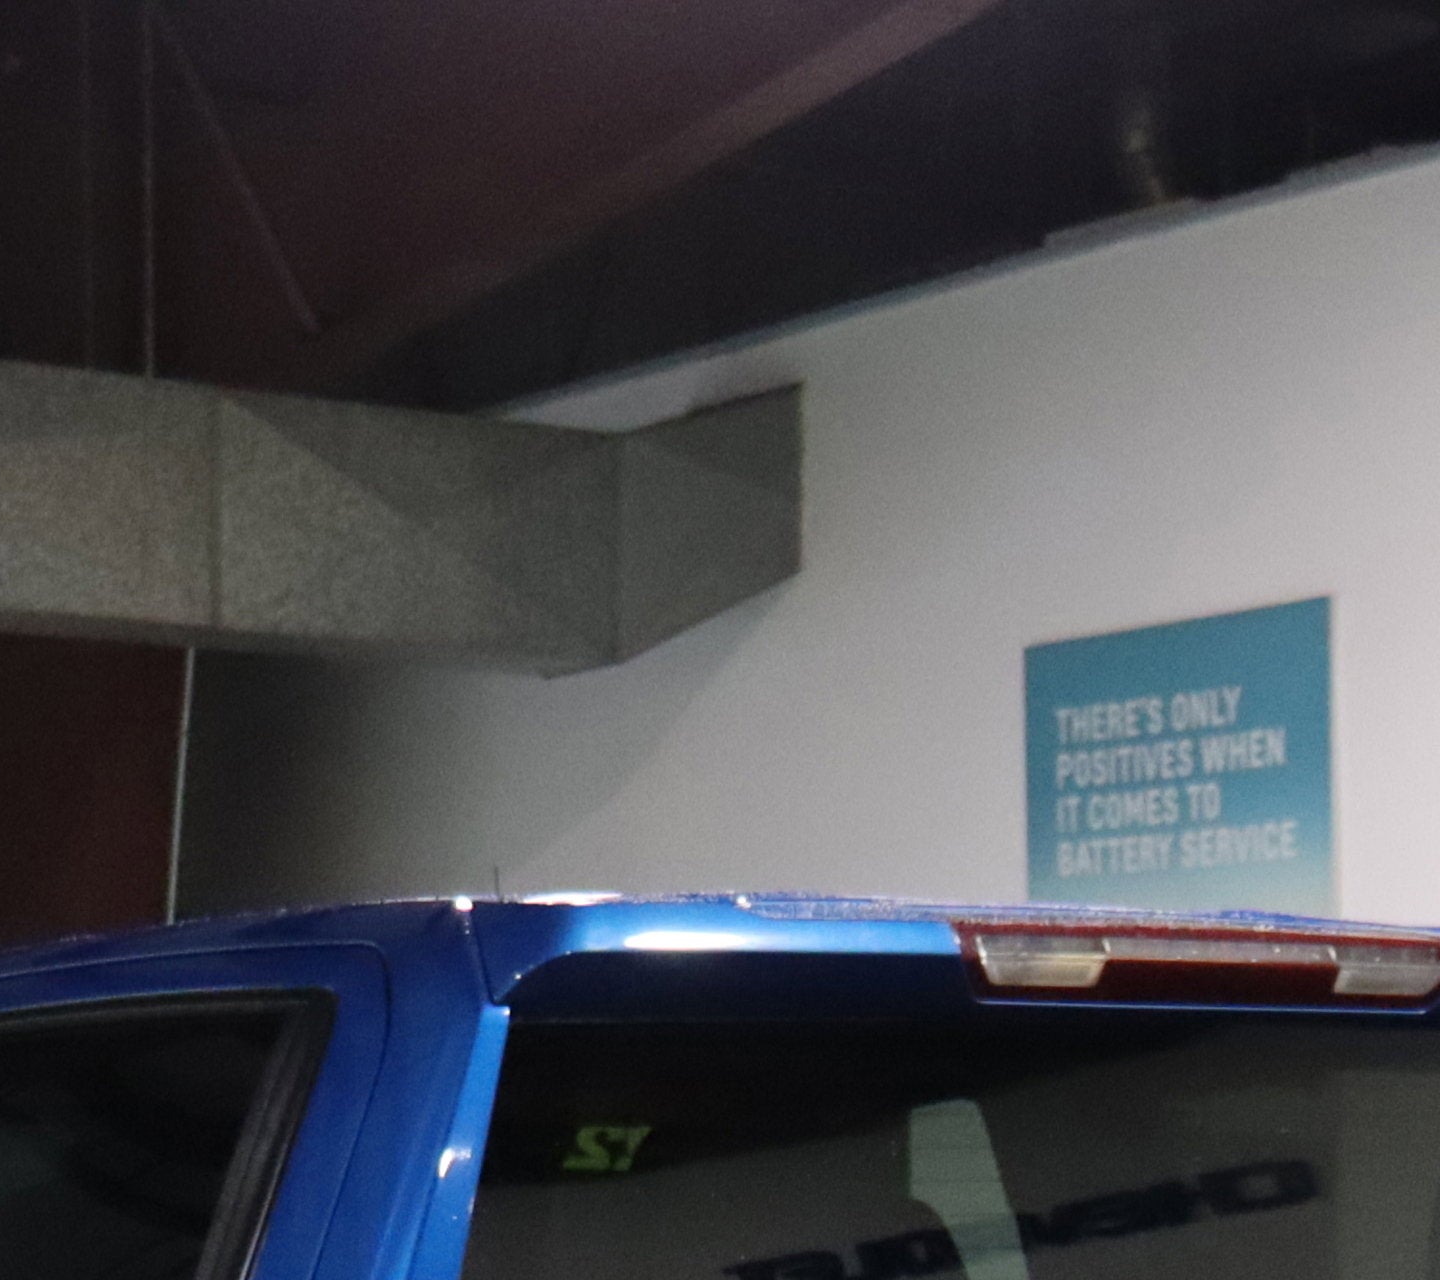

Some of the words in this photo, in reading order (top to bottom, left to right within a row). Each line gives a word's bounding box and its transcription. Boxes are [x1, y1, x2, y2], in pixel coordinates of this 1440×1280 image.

[1055, 697, 1164, 745] THERE'S
[1171, 684, 1242, 733] ONLY
[1056, 738, 1195, 788] POSITIVES
[1199, 726, 1288, 774] WHEN
[1057, 796, 1080, 833] IT
[1087, 786, 1180, 831] COMES
[1185, 782, 1222, 821] TO
[1057, 834, 1175, 878] BATTERY
[1180, 819, 1299, 868] SERVICE
